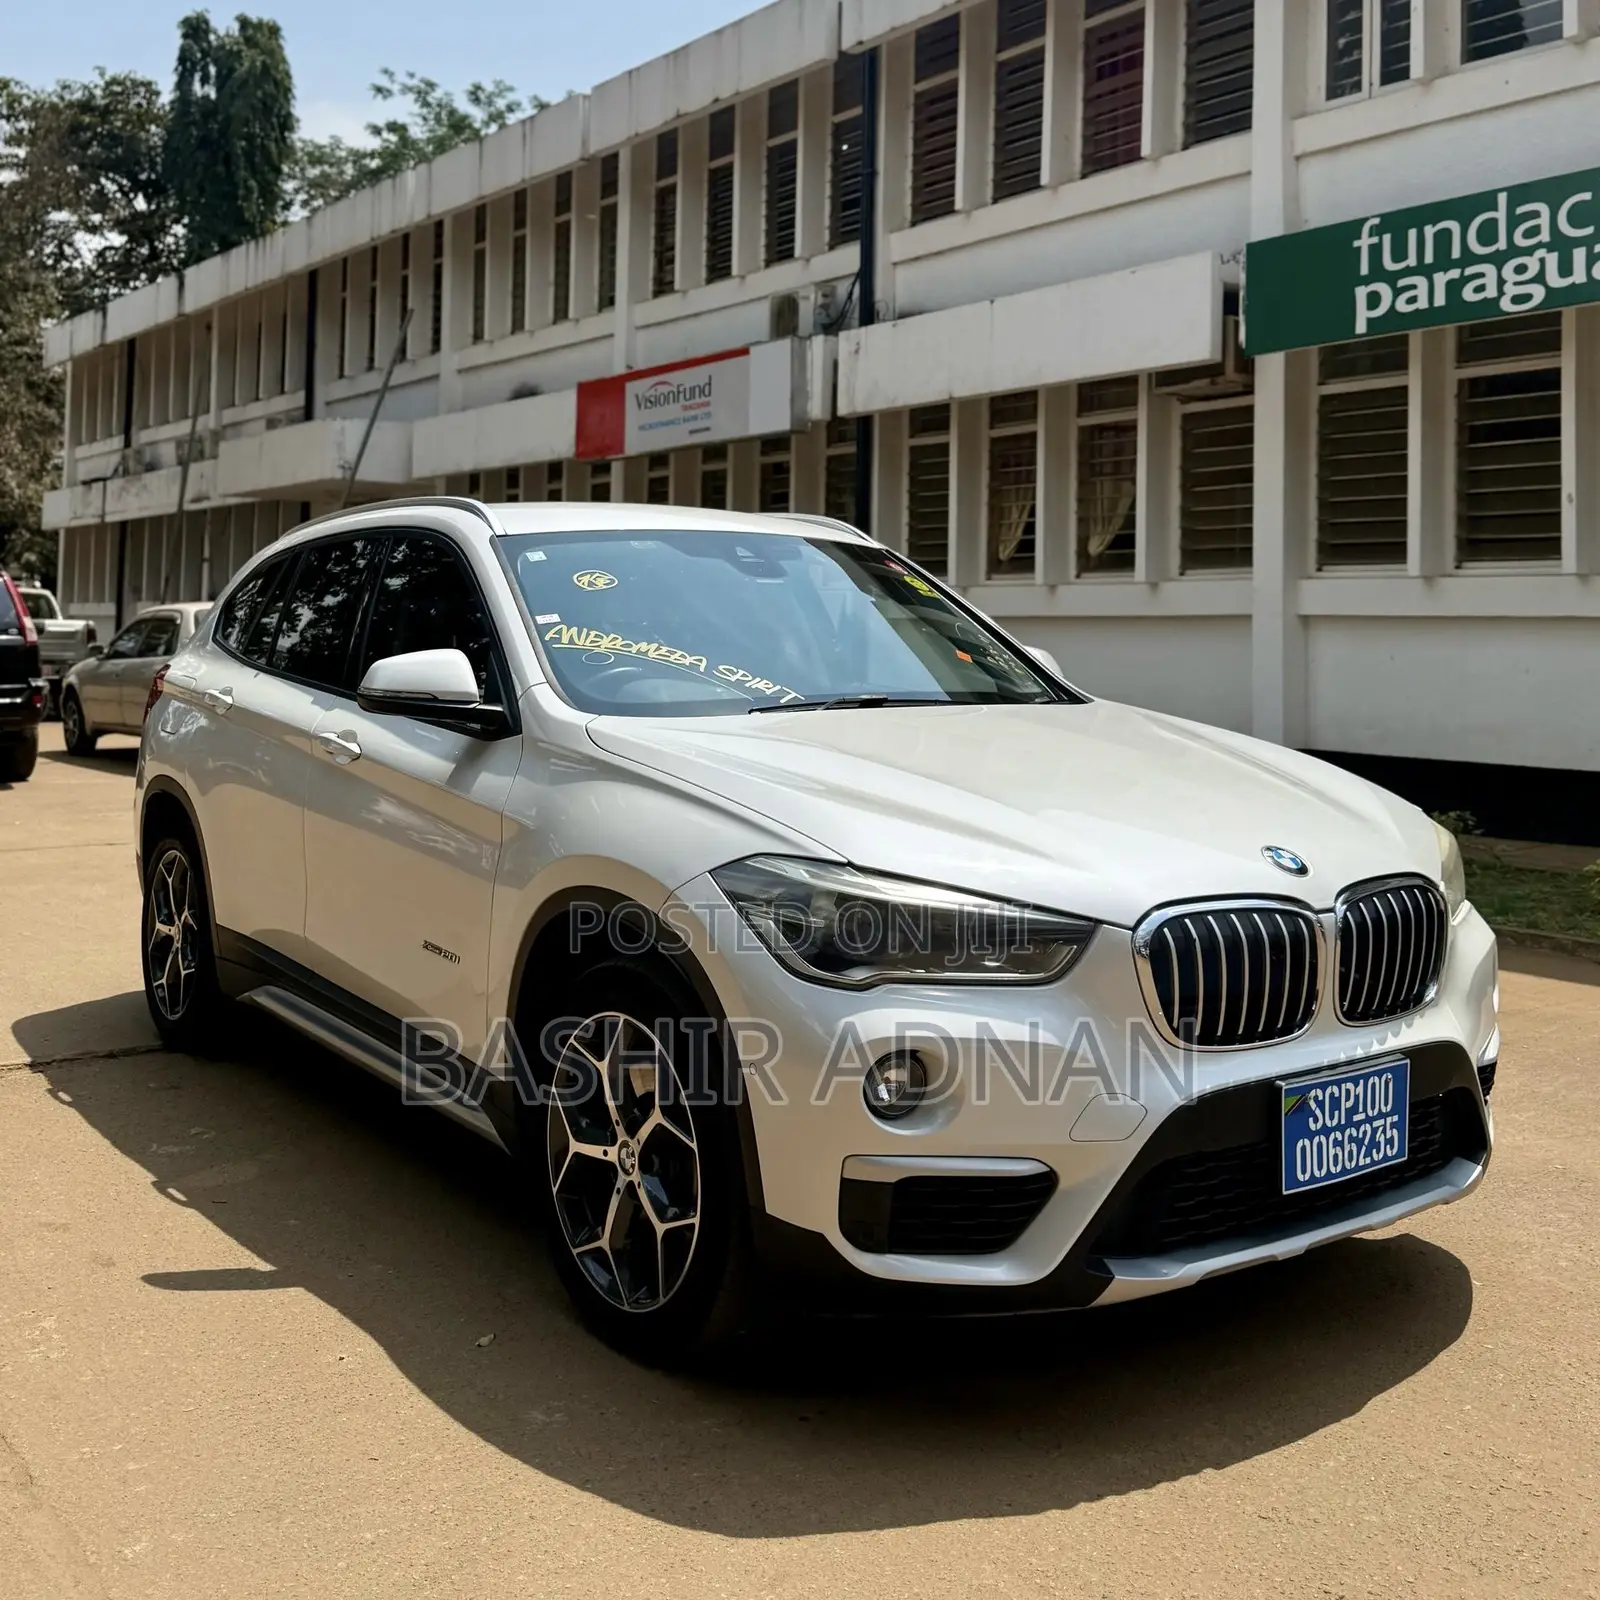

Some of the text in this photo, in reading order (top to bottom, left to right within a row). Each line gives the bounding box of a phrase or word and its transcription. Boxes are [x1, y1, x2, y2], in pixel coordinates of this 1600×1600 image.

[1353, 191, 1595, 276] fundac
[1354, 243, 1600, 334] paragu
[634, 374, 712, 411] VisionFund
[712, 664, 805, 703] SPIRIT
[1308, 1072, 1393, 1131] SCP100
[1295, 1115, 1399, 1182] 0066235
